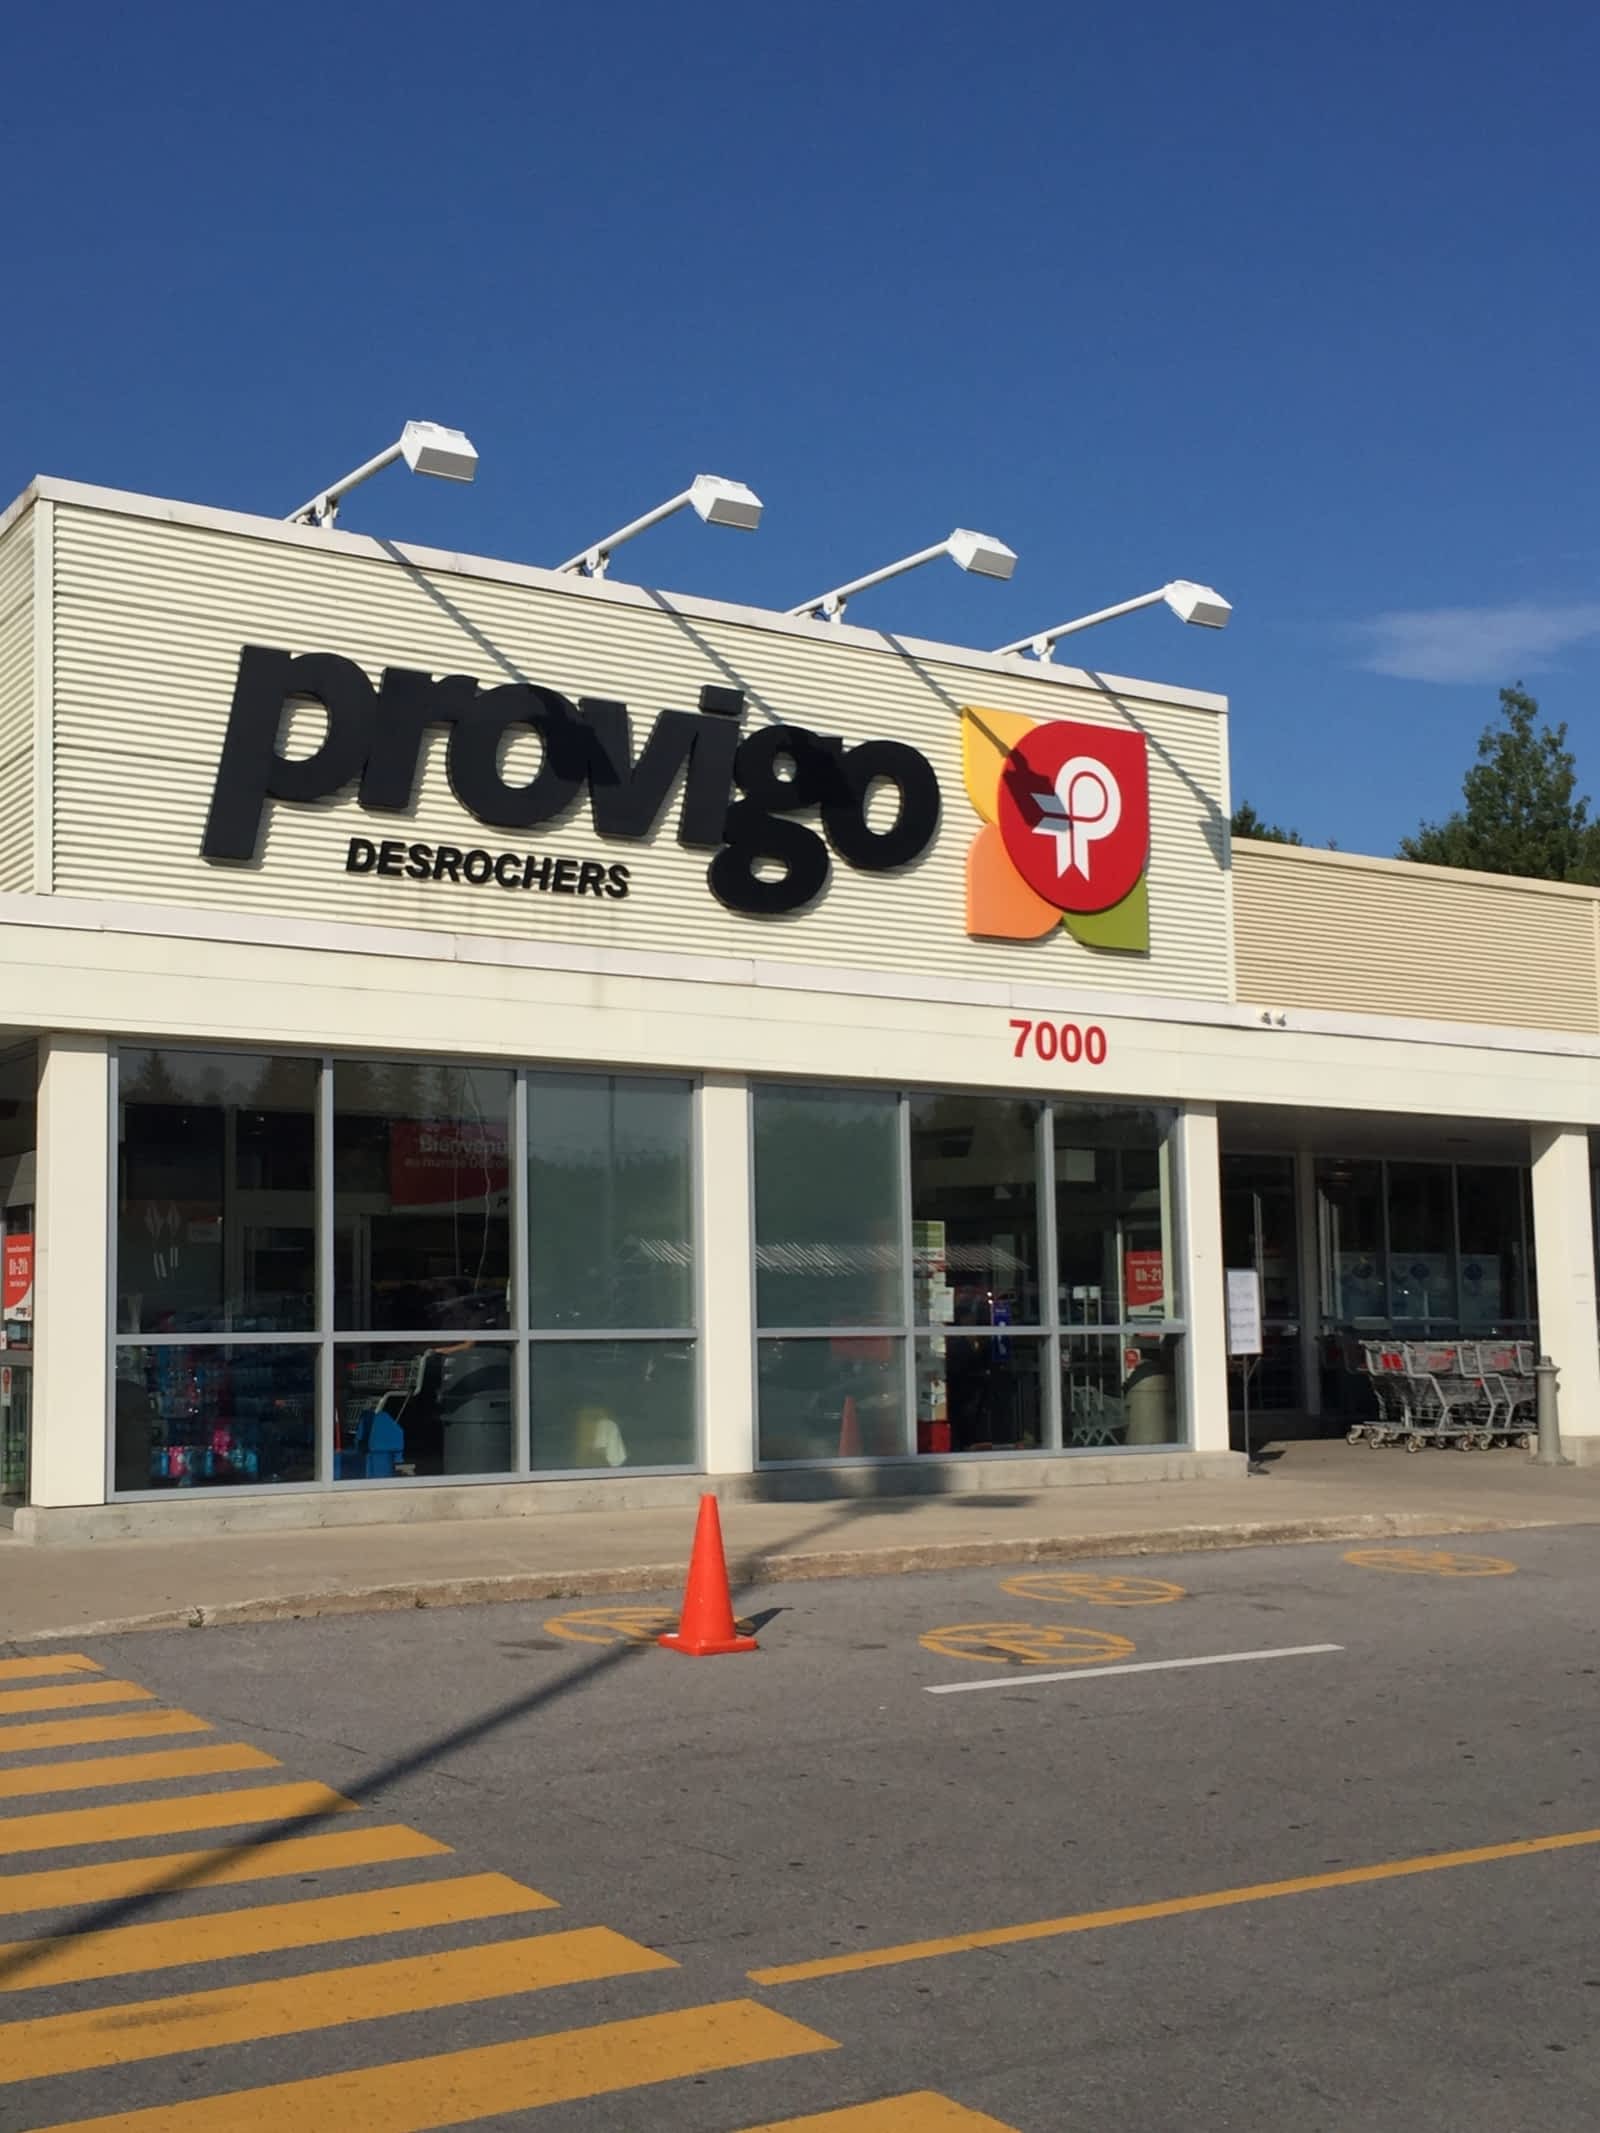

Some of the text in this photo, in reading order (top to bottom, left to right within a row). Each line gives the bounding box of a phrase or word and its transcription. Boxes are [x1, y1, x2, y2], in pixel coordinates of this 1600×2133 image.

[201, 645, 941, 914] provigo
[346, 837, 631, 899] DESROCHERS
[1008, 1018, 1107, 1065] 7000
